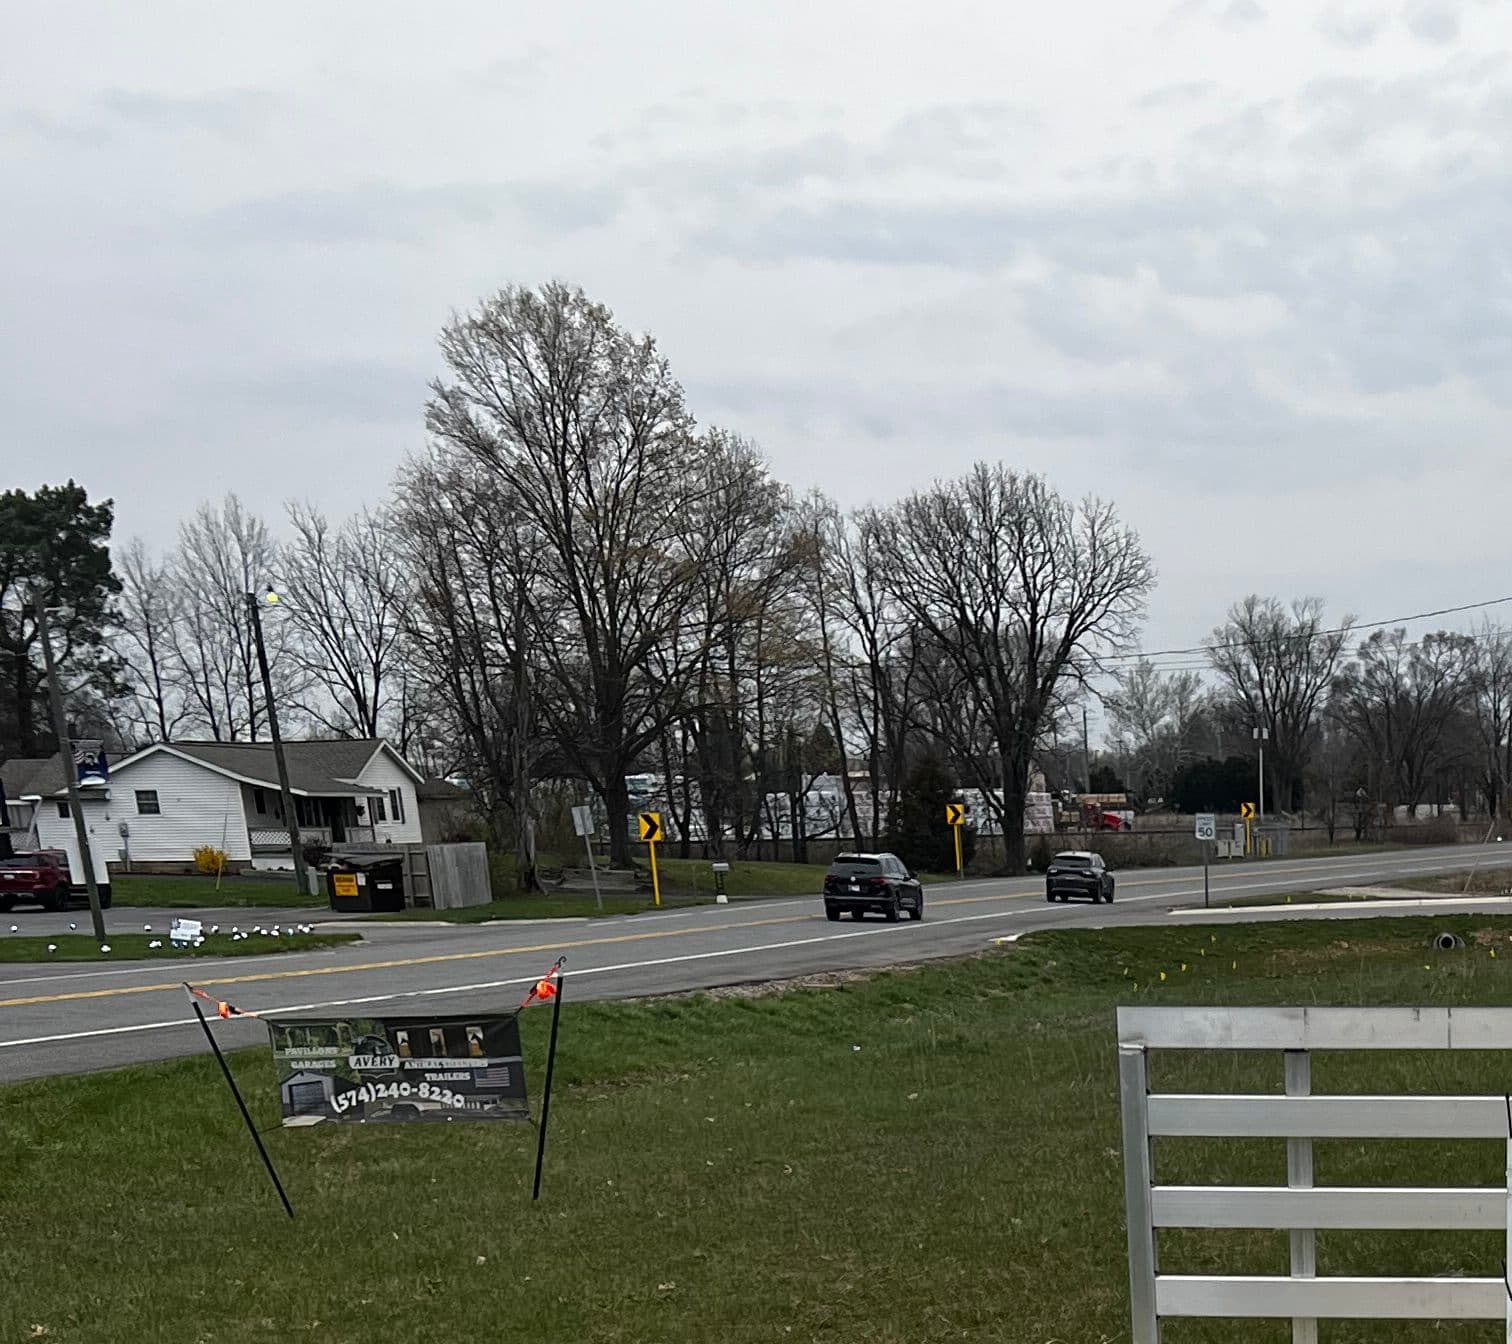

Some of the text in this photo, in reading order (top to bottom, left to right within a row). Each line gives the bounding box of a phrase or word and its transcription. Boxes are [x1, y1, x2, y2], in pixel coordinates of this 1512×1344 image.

[1198, 827, 1213, 837] 50
[353, 1055, 396, 1067] AVERY
[424, 1071, 471, 1081] TRAILERS
[330, 1081, 465, 1113] (574)240-8220
